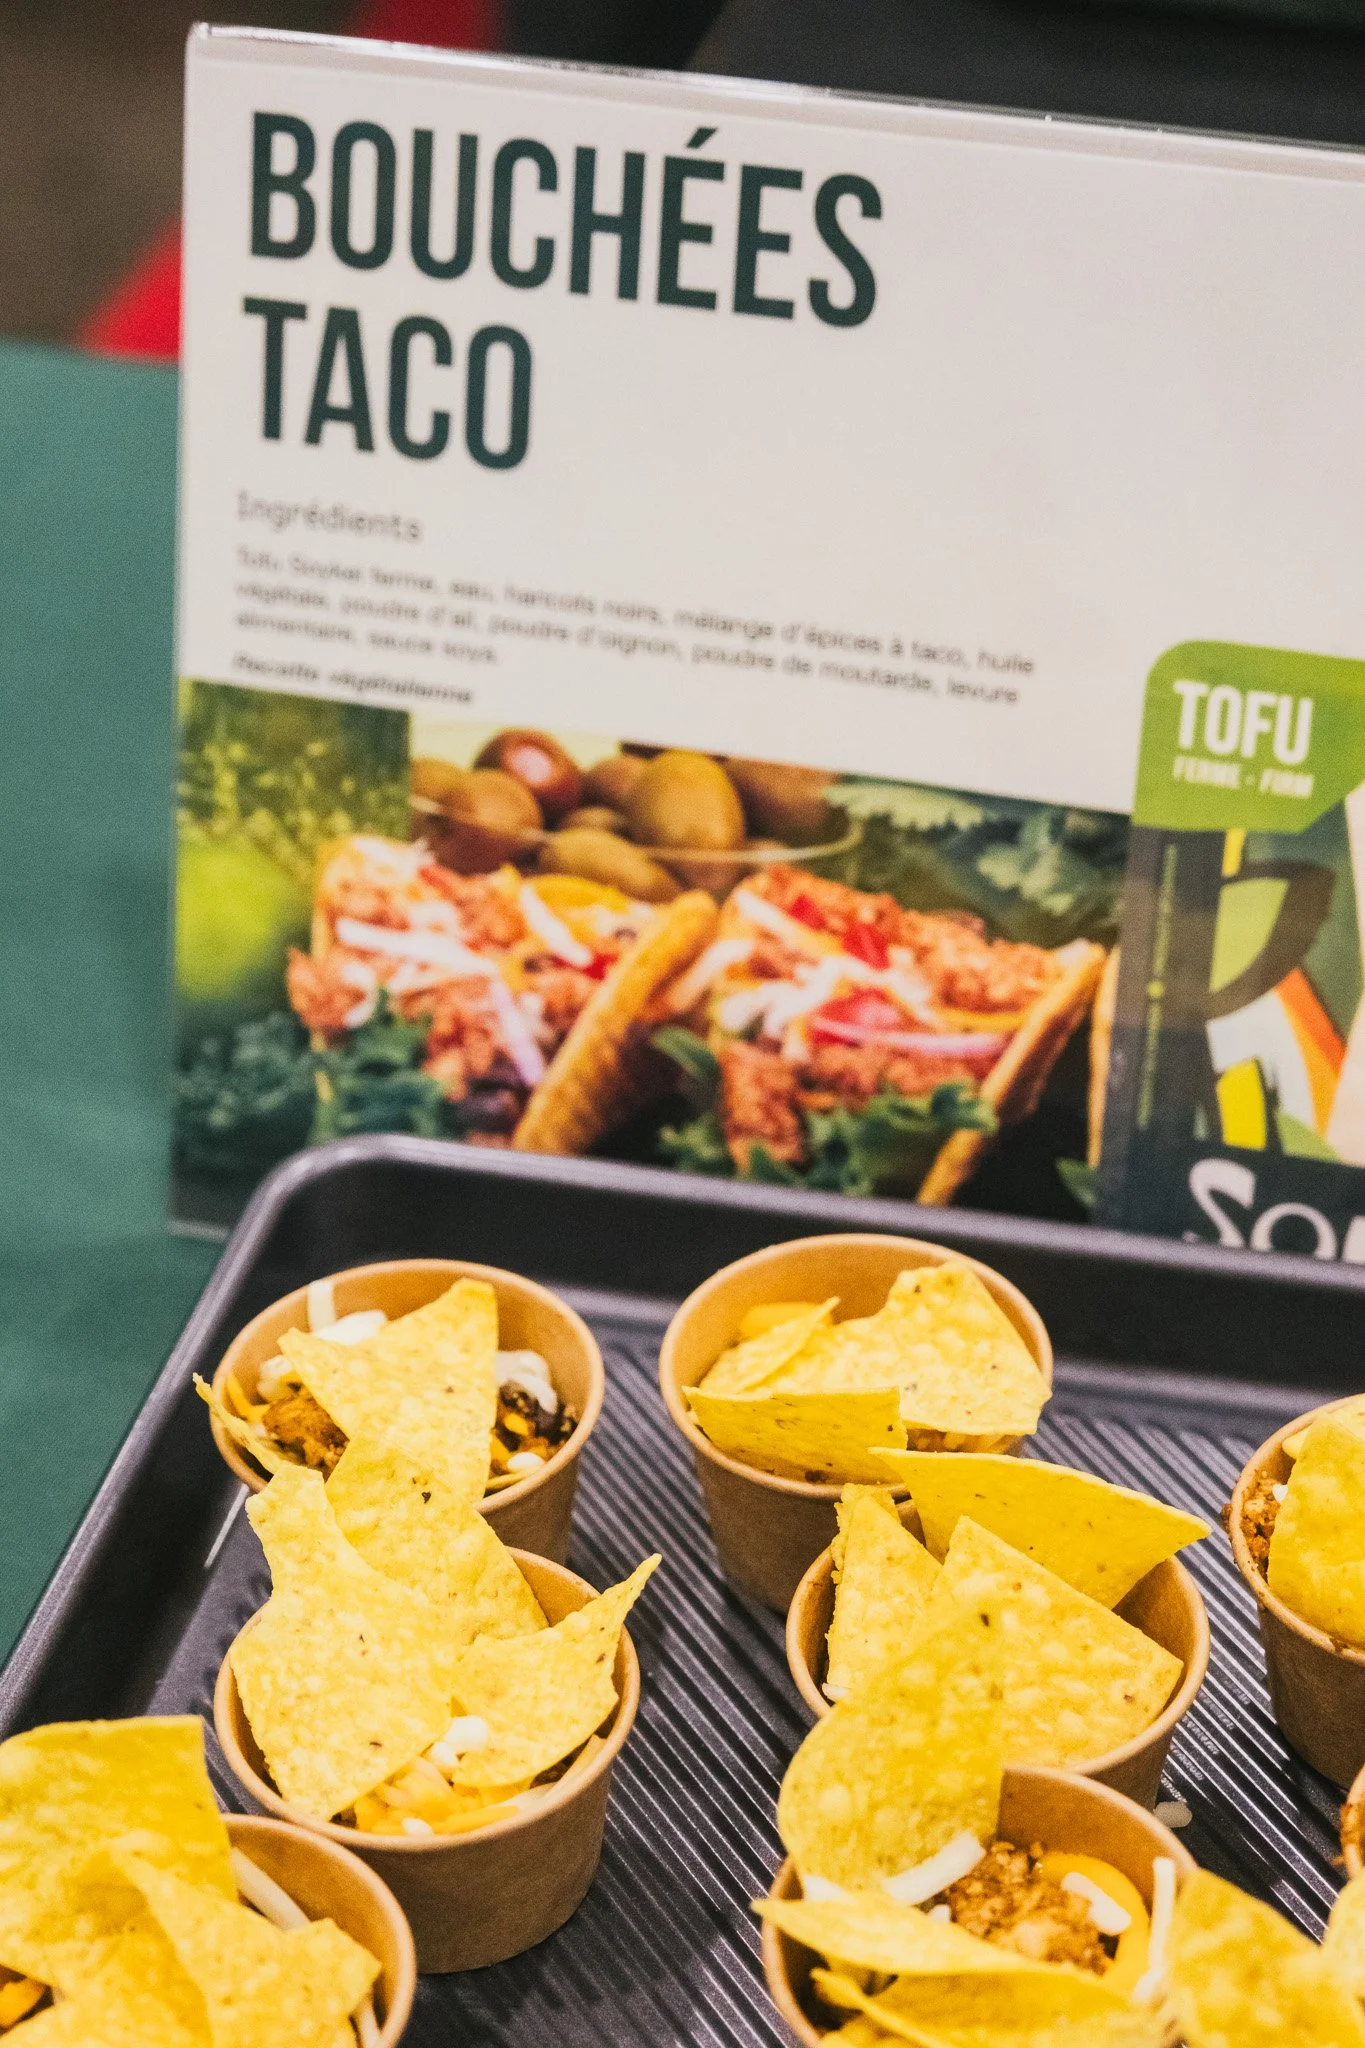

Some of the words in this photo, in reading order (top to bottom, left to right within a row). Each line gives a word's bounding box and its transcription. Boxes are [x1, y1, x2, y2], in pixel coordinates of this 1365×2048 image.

[250, 112, 883, 329] BOUCHÉES
[242, 296, 533, 471] TACO
[237, 489, 423, 542] Ingrédients
[690, 642, 775, 671] poudre
[781, 654, 812, 676] de
[947, 675, 1020, 705] levure
[976, 648, 1035, 677] huile
[1173, 679, 1315, 766] TOFU
